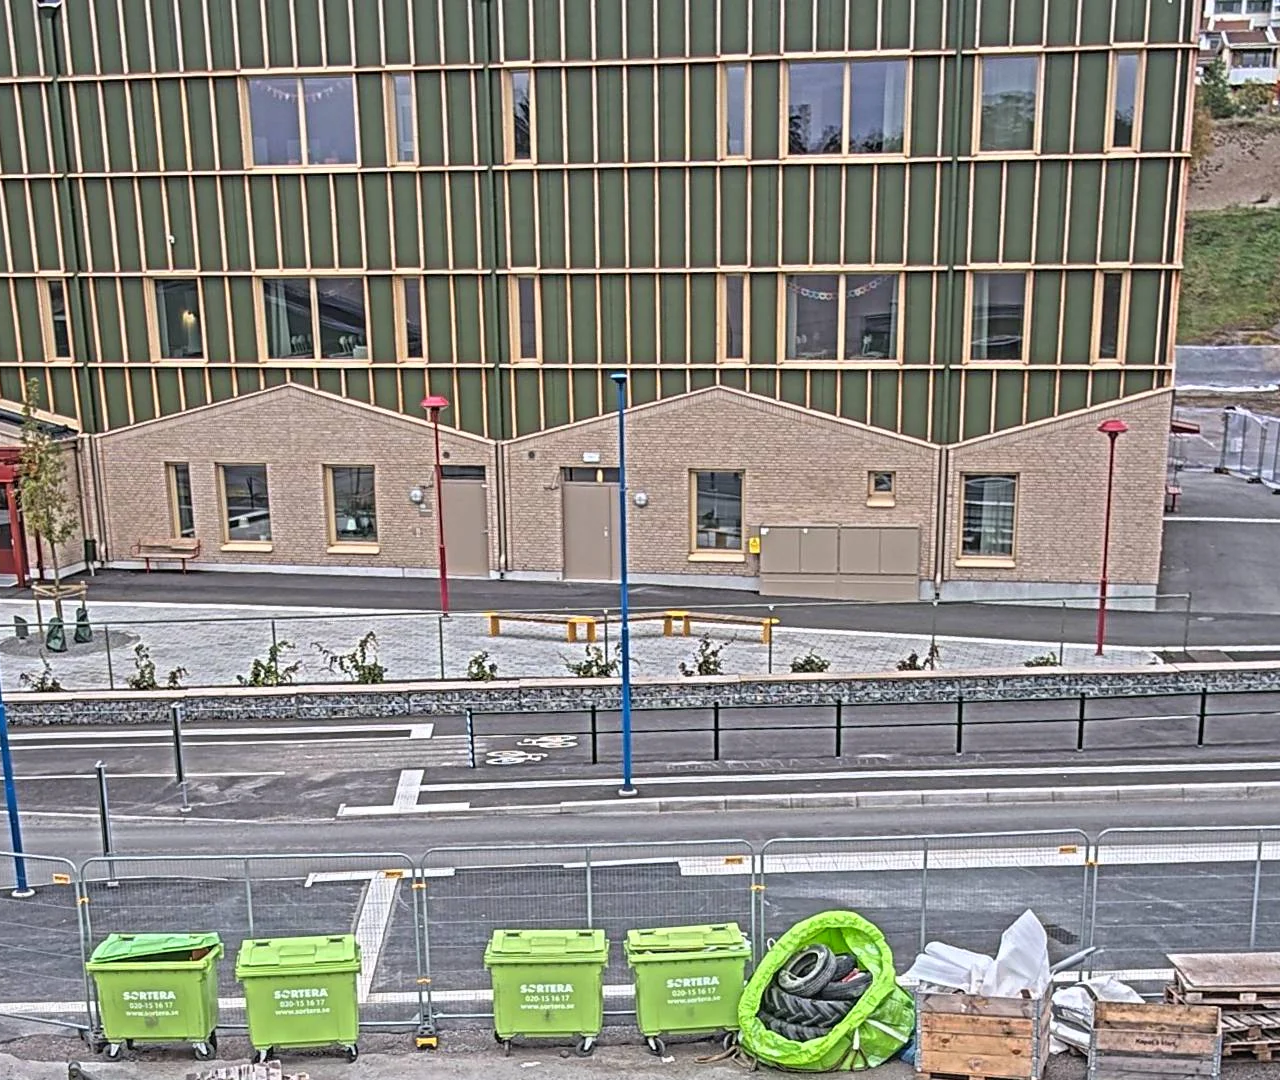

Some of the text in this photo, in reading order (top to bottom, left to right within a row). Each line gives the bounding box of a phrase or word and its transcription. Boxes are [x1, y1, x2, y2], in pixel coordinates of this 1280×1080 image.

[667, 976, 719, 988] SORTERA
[274, 988, 328, 999] SORTERA
[520, 984, 574, 994] SORTERA
[123, 991, 176, 1000] SORTERA
